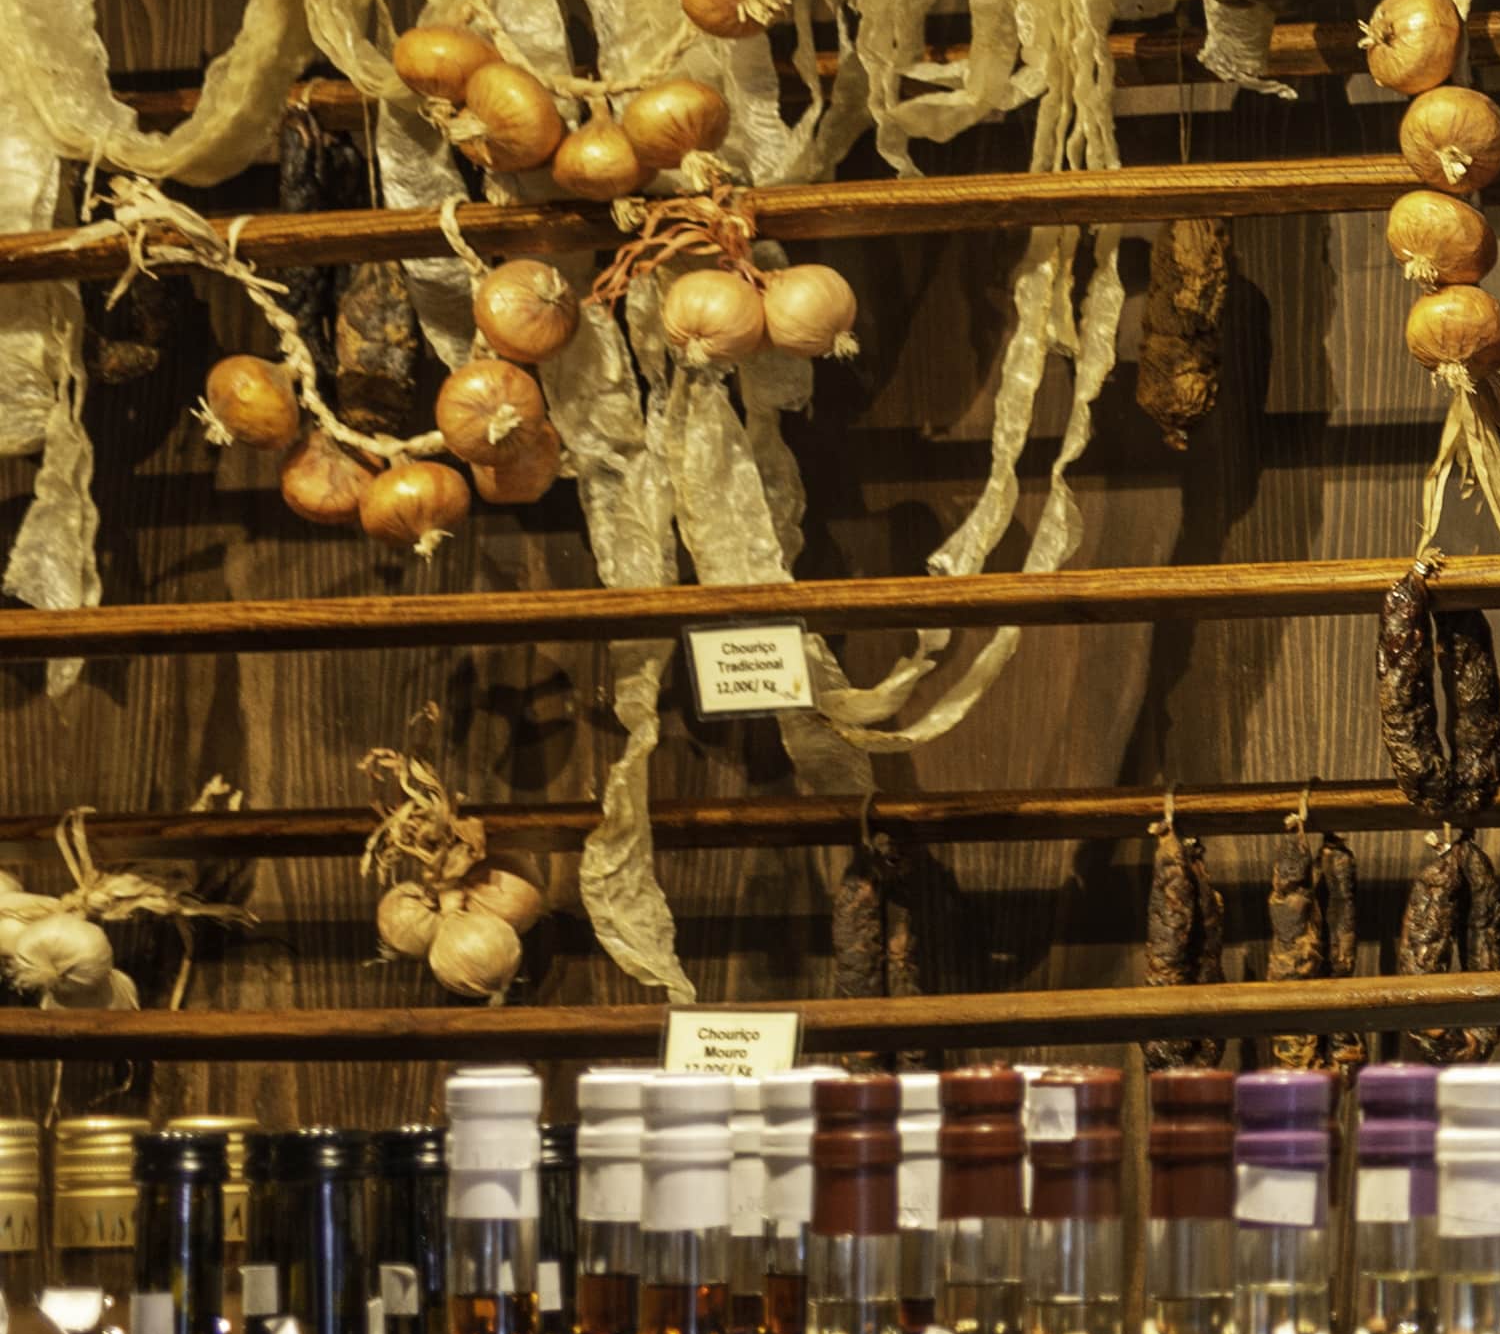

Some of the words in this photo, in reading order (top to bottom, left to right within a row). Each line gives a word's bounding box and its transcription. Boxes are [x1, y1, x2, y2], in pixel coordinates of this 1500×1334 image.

[721, 641, 777, 656] Chouriço
[716, 658, 785, 674] Tradicional
[697, 1027, 761, 1042] Chouriço
[703, 1045, 748, 1059] Mouro
